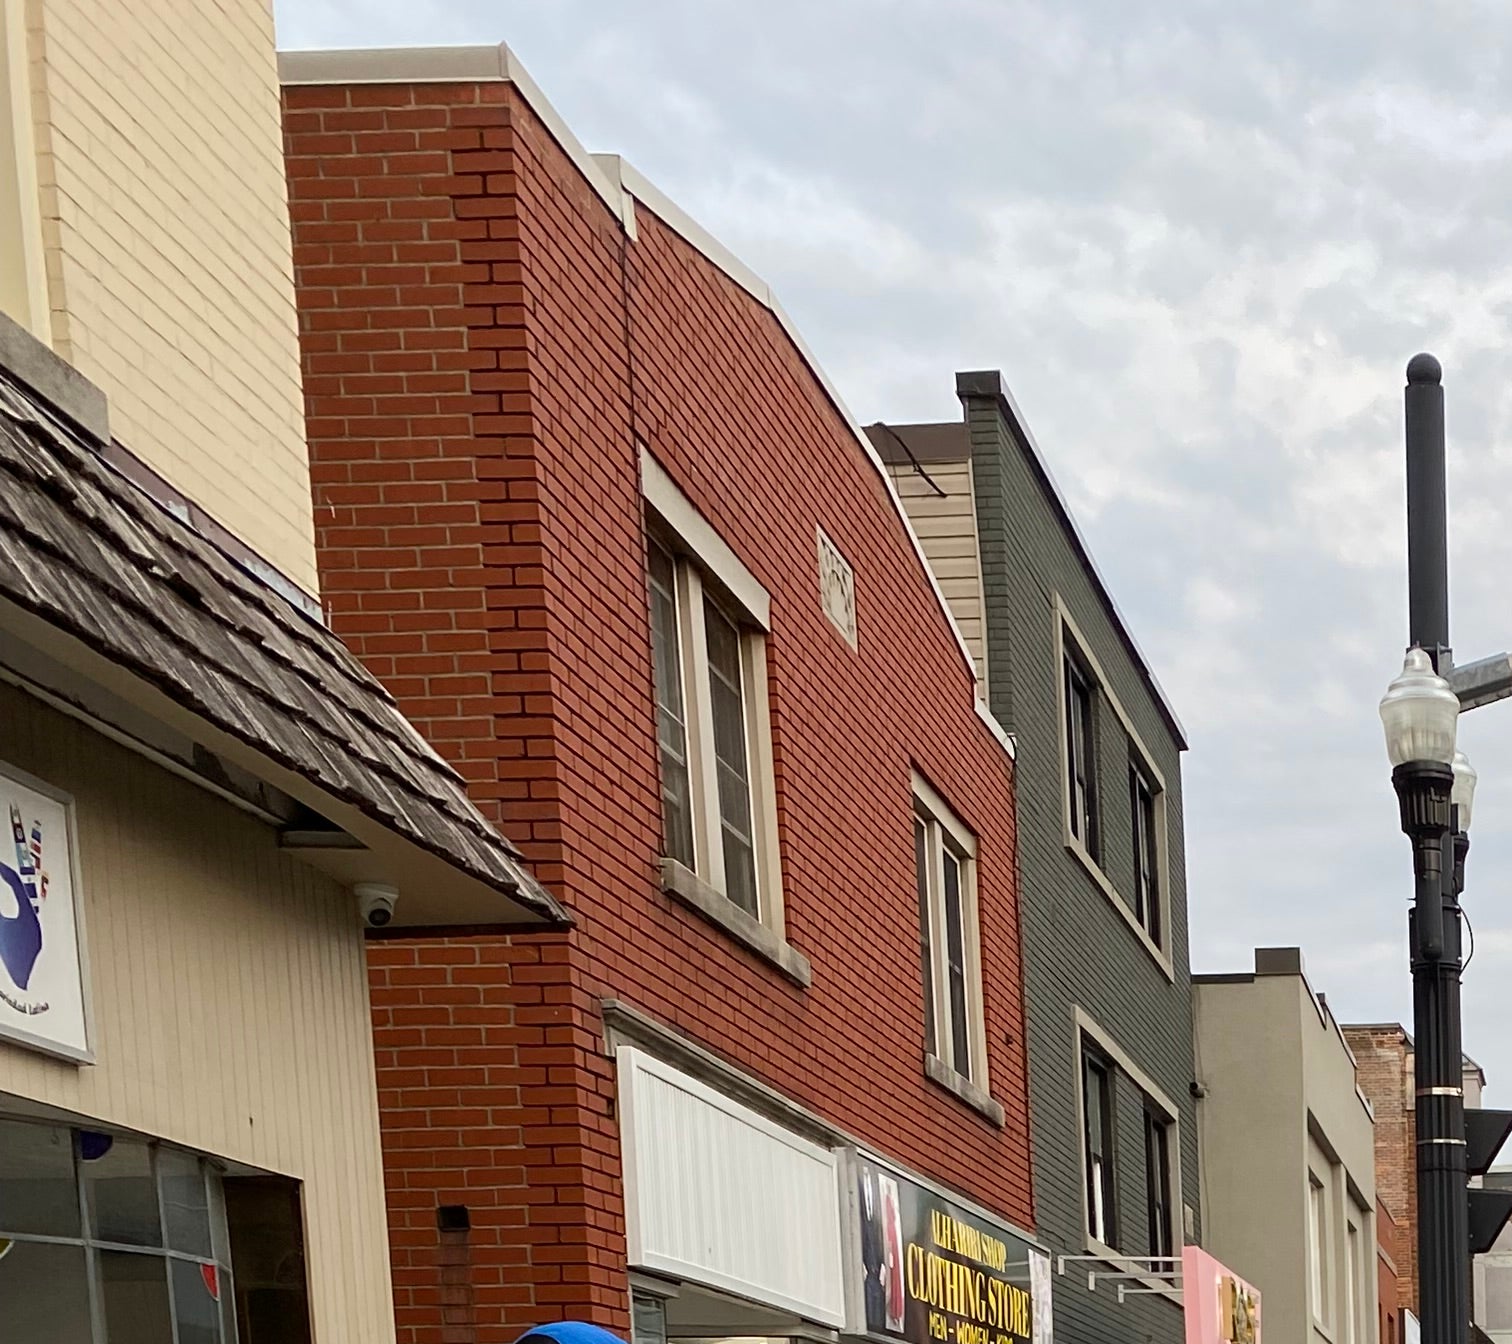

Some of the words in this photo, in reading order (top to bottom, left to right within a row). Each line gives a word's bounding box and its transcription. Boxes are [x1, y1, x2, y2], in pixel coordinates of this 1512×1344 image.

[981, 1232, 1008, 1273] SHOP
[907, 1242, 987, 1323] CLOTHING
[988, 1276, 1031, 1339] STORE
[928, 1310, 948, 1342] MEN
